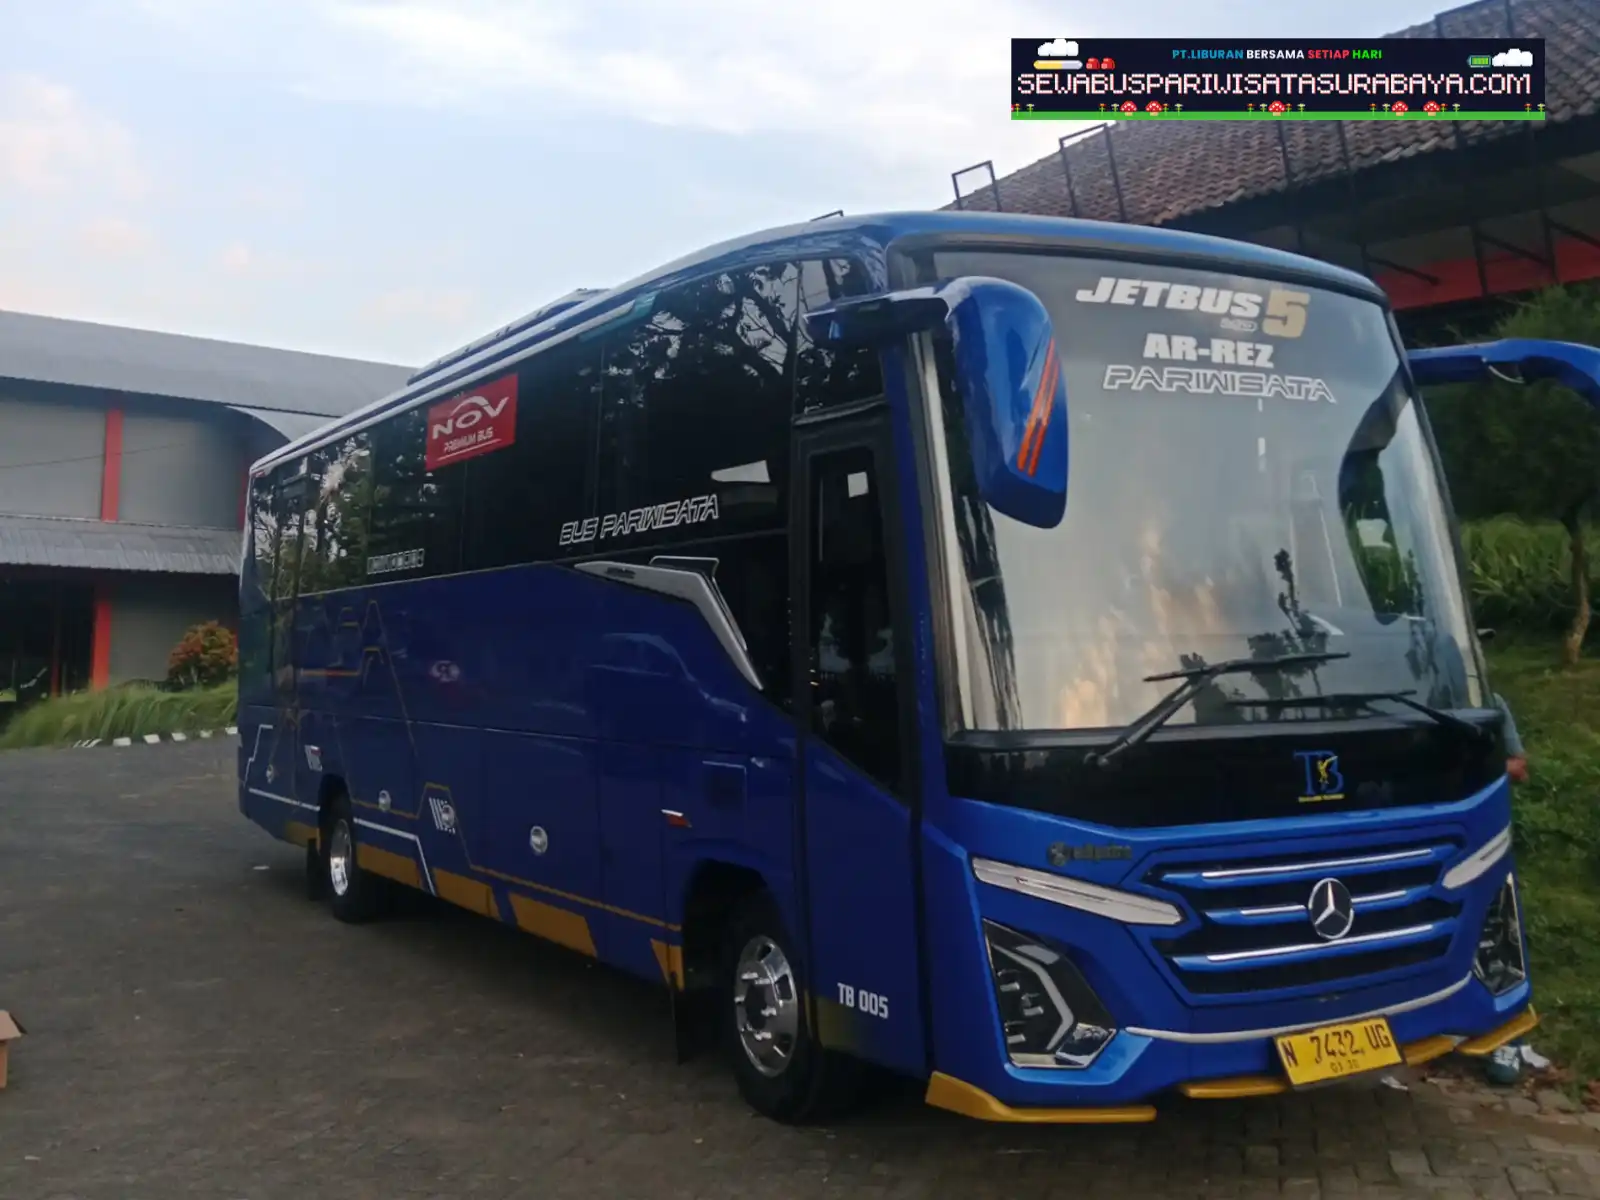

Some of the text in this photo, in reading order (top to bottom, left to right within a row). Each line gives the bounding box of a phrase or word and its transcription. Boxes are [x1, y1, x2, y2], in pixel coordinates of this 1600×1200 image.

[1142, 332, 1275, 369] AR-REZ
[1102, 364, 1337, 404] PARIWISATA
[477, 426, 494, 442] BUS
[558, 493, 720, 546] BUS PARIWISATA
[837, 982, 890, 1019] TB 005
[1280, 1023, 1393, 1068] N 7432 UG
